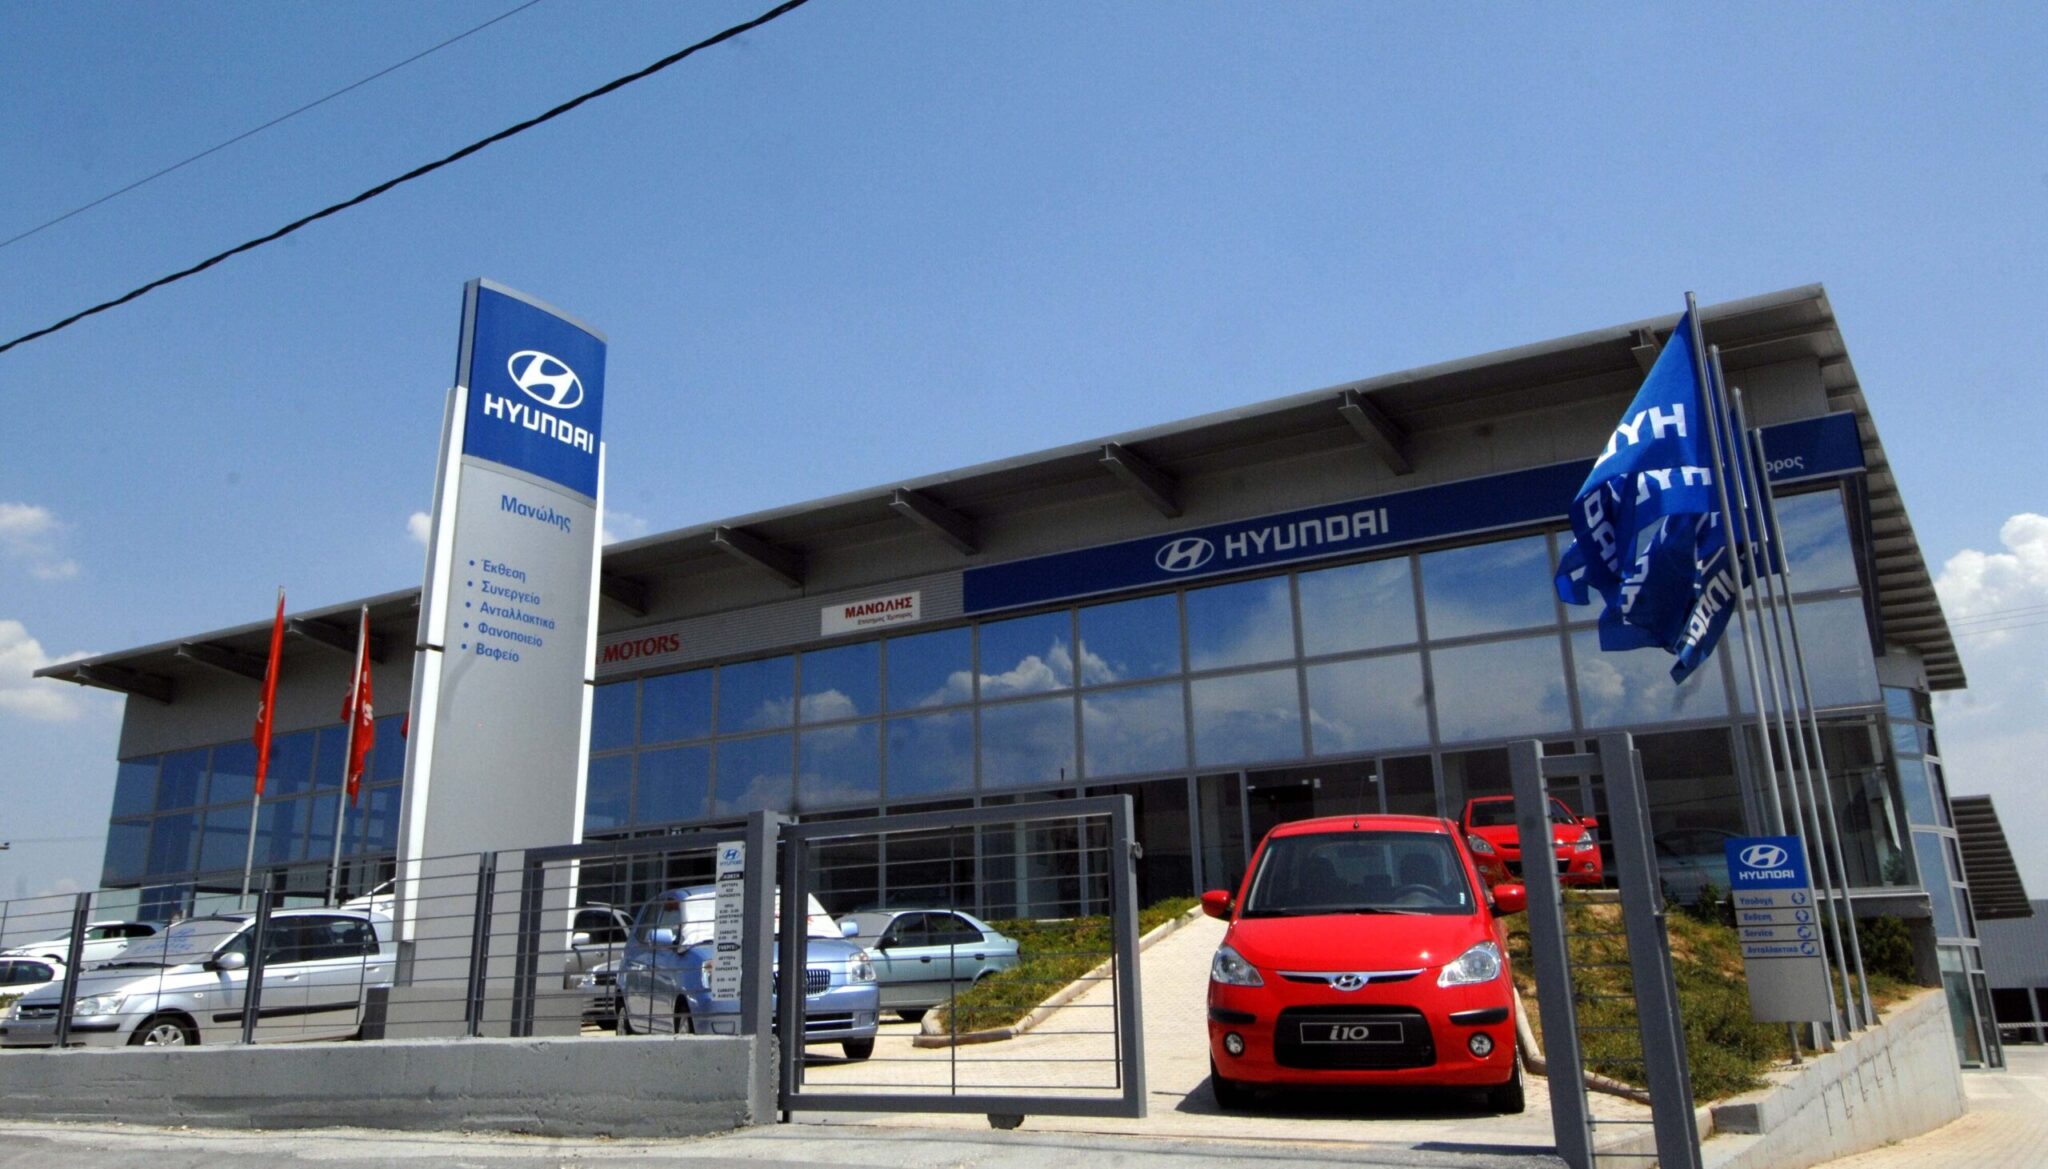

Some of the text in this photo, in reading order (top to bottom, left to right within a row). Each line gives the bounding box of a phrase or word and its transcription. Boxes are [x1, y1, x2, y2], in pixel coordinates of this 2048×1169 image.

[483, 392, 595, 455] HYUNDAI
[501, 494, 571, 533] Μανώλης
[1225, 508, 1388, 559] HYUNDAI
[480, 559, 526, 584] Έκθεση
[481, 580, 541, 605] Συνεργείο
[480, 601, 556, 630] Ανταλλακτικά
[844, 596, 913, 619] ΜΑΝΩΛΗΣ
[478, 622, 543, 648] Φανοποιείο
[476, 642, 520, 662] Βαφείο
[602, 633, 680, 664] MOTORS
[1738, 870, 1795, 880] HYUNDAI
[1744, 929, 1774, 937] Service
[1329, 1025, 1369, 1041] i10
